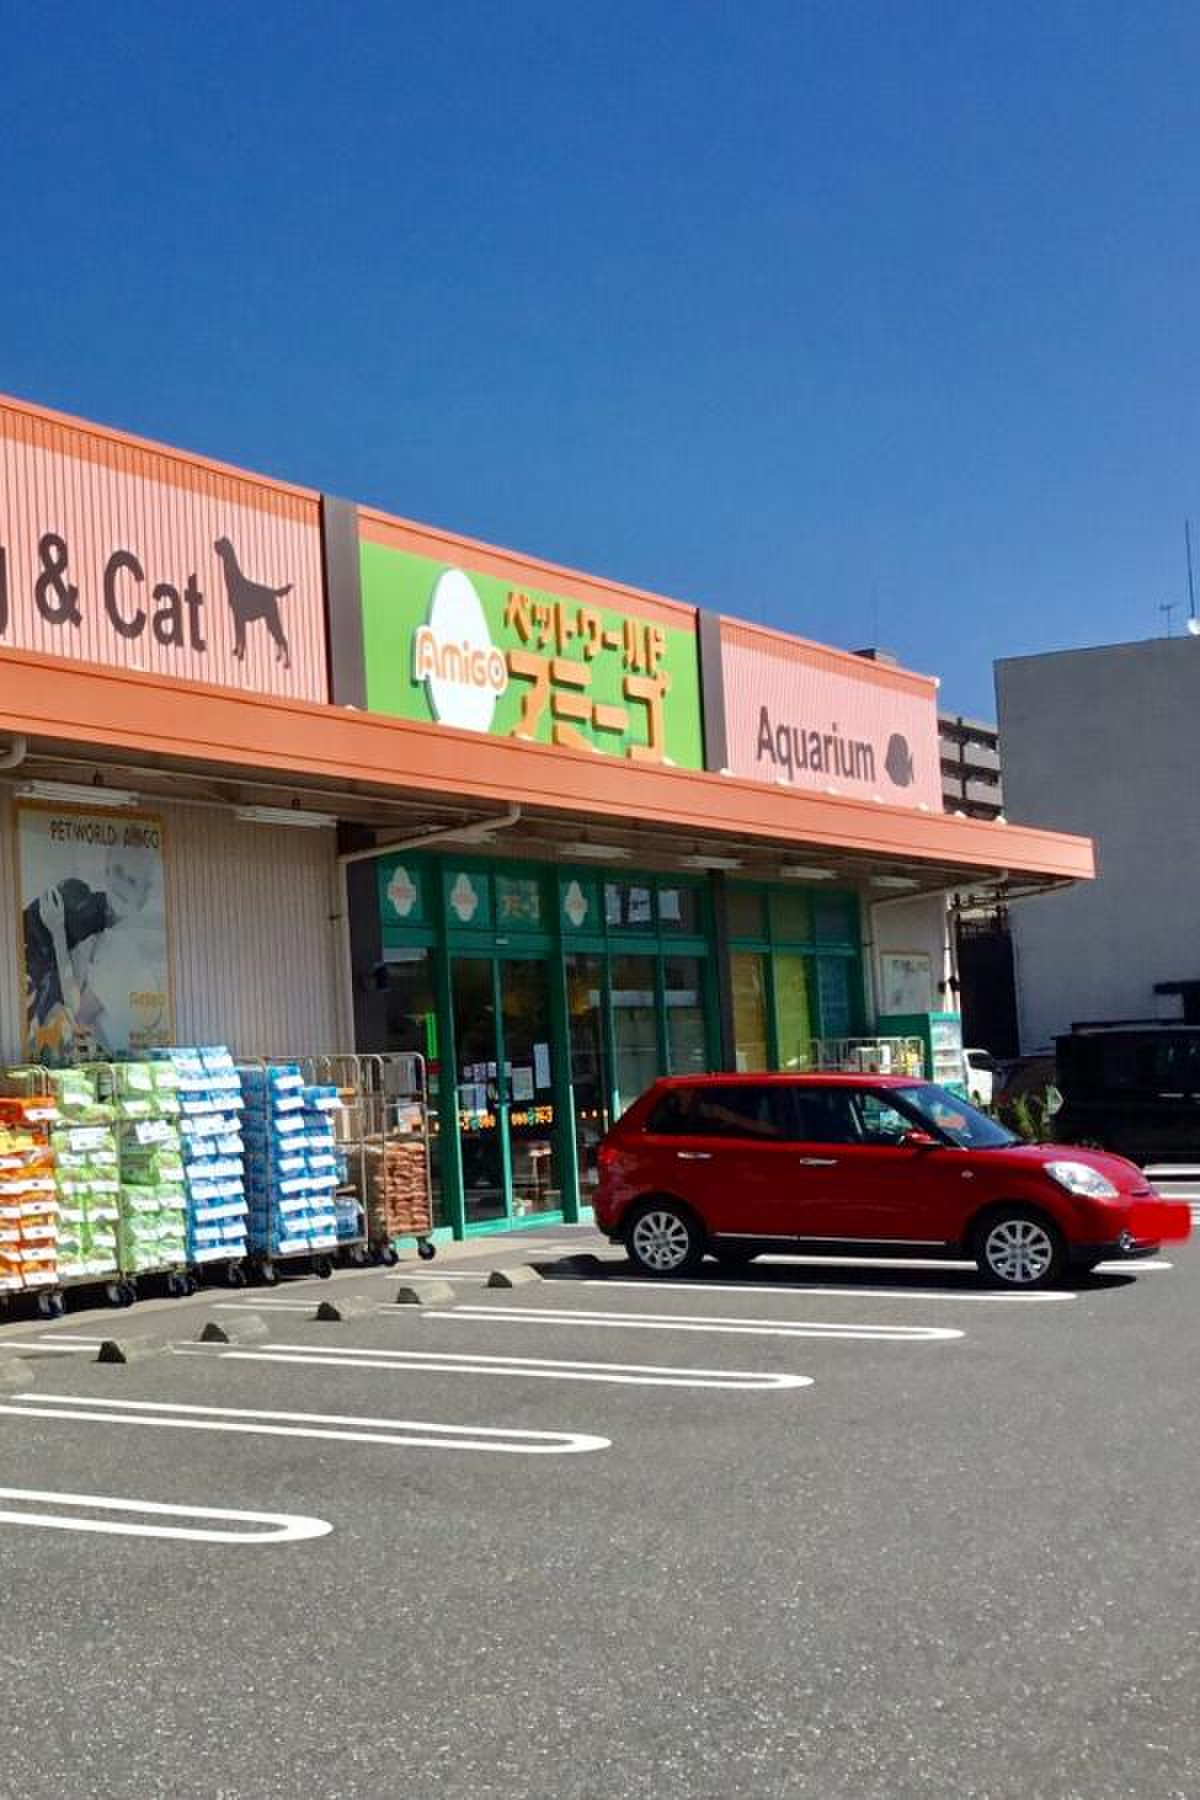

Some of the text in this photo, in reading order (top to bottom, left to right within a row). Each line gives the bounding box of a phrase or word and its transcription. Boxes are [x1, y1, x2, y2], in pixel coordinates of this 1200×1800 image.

[35, 532, 82, 628] &
[103, 549, 206, 652] Cat
[506, 650, 670, 764] アミーゴ
[757, 705, 876, 782] Aquarium
